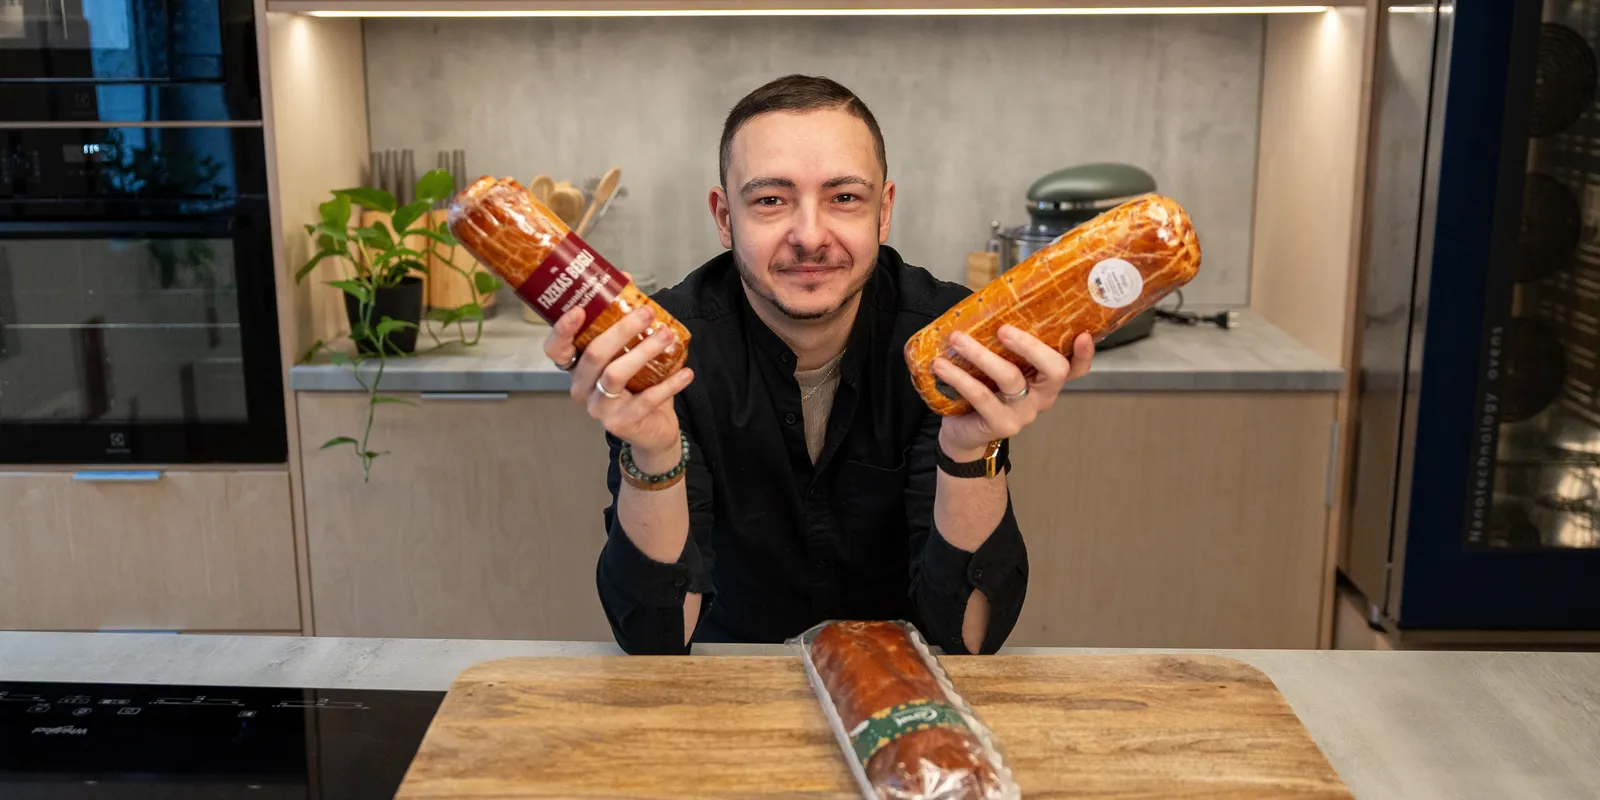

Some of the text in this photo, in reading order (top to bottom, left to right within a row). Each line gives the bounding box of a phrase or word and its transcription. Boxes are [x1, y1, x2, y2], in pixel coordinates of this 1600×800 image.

[537, 248, 595, 310] FAZEKAS BEIGLI
[1468, 326, 1503, 542] Nanotechnology ovens
